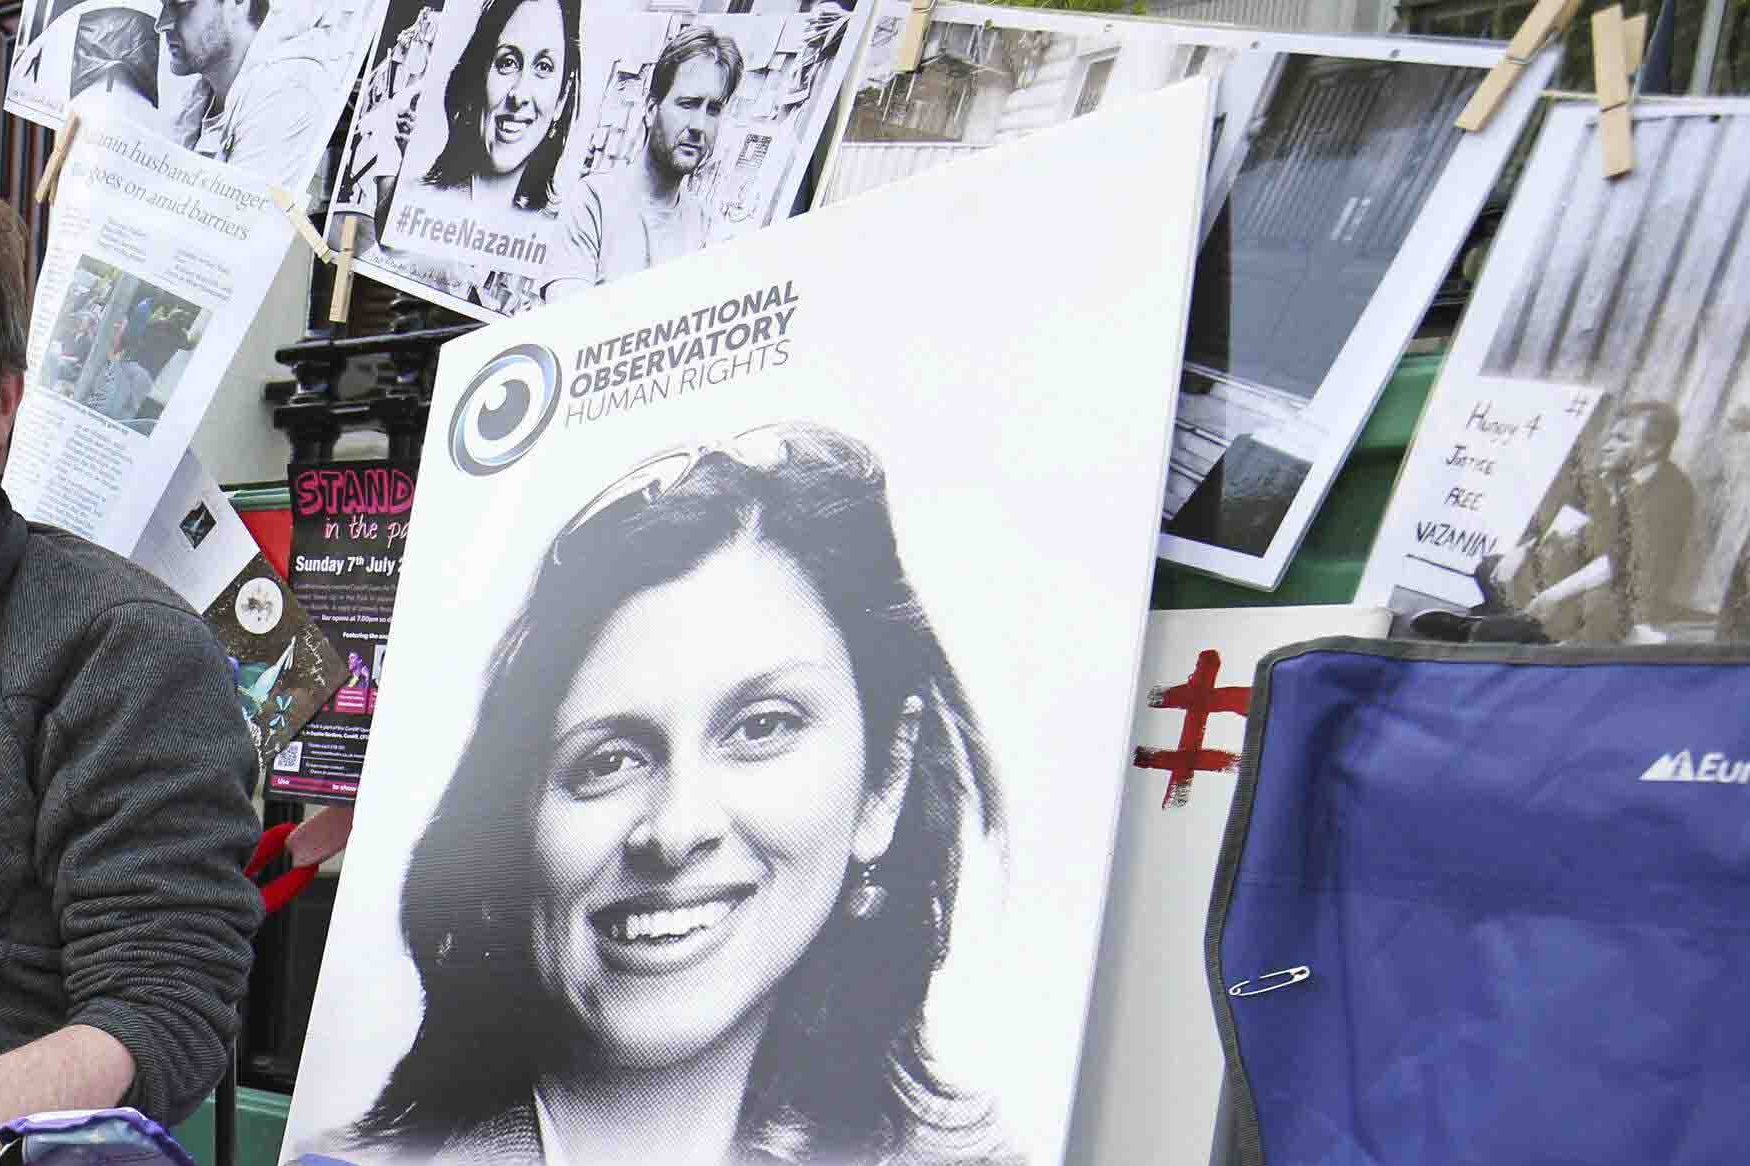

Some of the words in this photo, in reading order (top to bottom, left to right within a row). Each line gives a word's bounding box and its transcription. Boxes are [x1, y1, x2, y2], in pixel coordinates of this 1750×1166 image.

[186, 202, 250, 241] barriers
[396, 204, 547, 265] #FreeNazanin
[575, 280, 799, 370] INTERNATIONAL
[569, 307, 797, 398] OBSERVATORY
[564, 376, 671, 428] HUMAN
[680, 337, 792, 395] RIGHTS
[297, 469, 414, 516] STAND
[324, 516, 339, 539] in
[349, 514, 378, 539] the
[295, 555, 344, 575] Sunday
[347, 555, 364, 572] 7th
[365, 557, 395, 577] July
